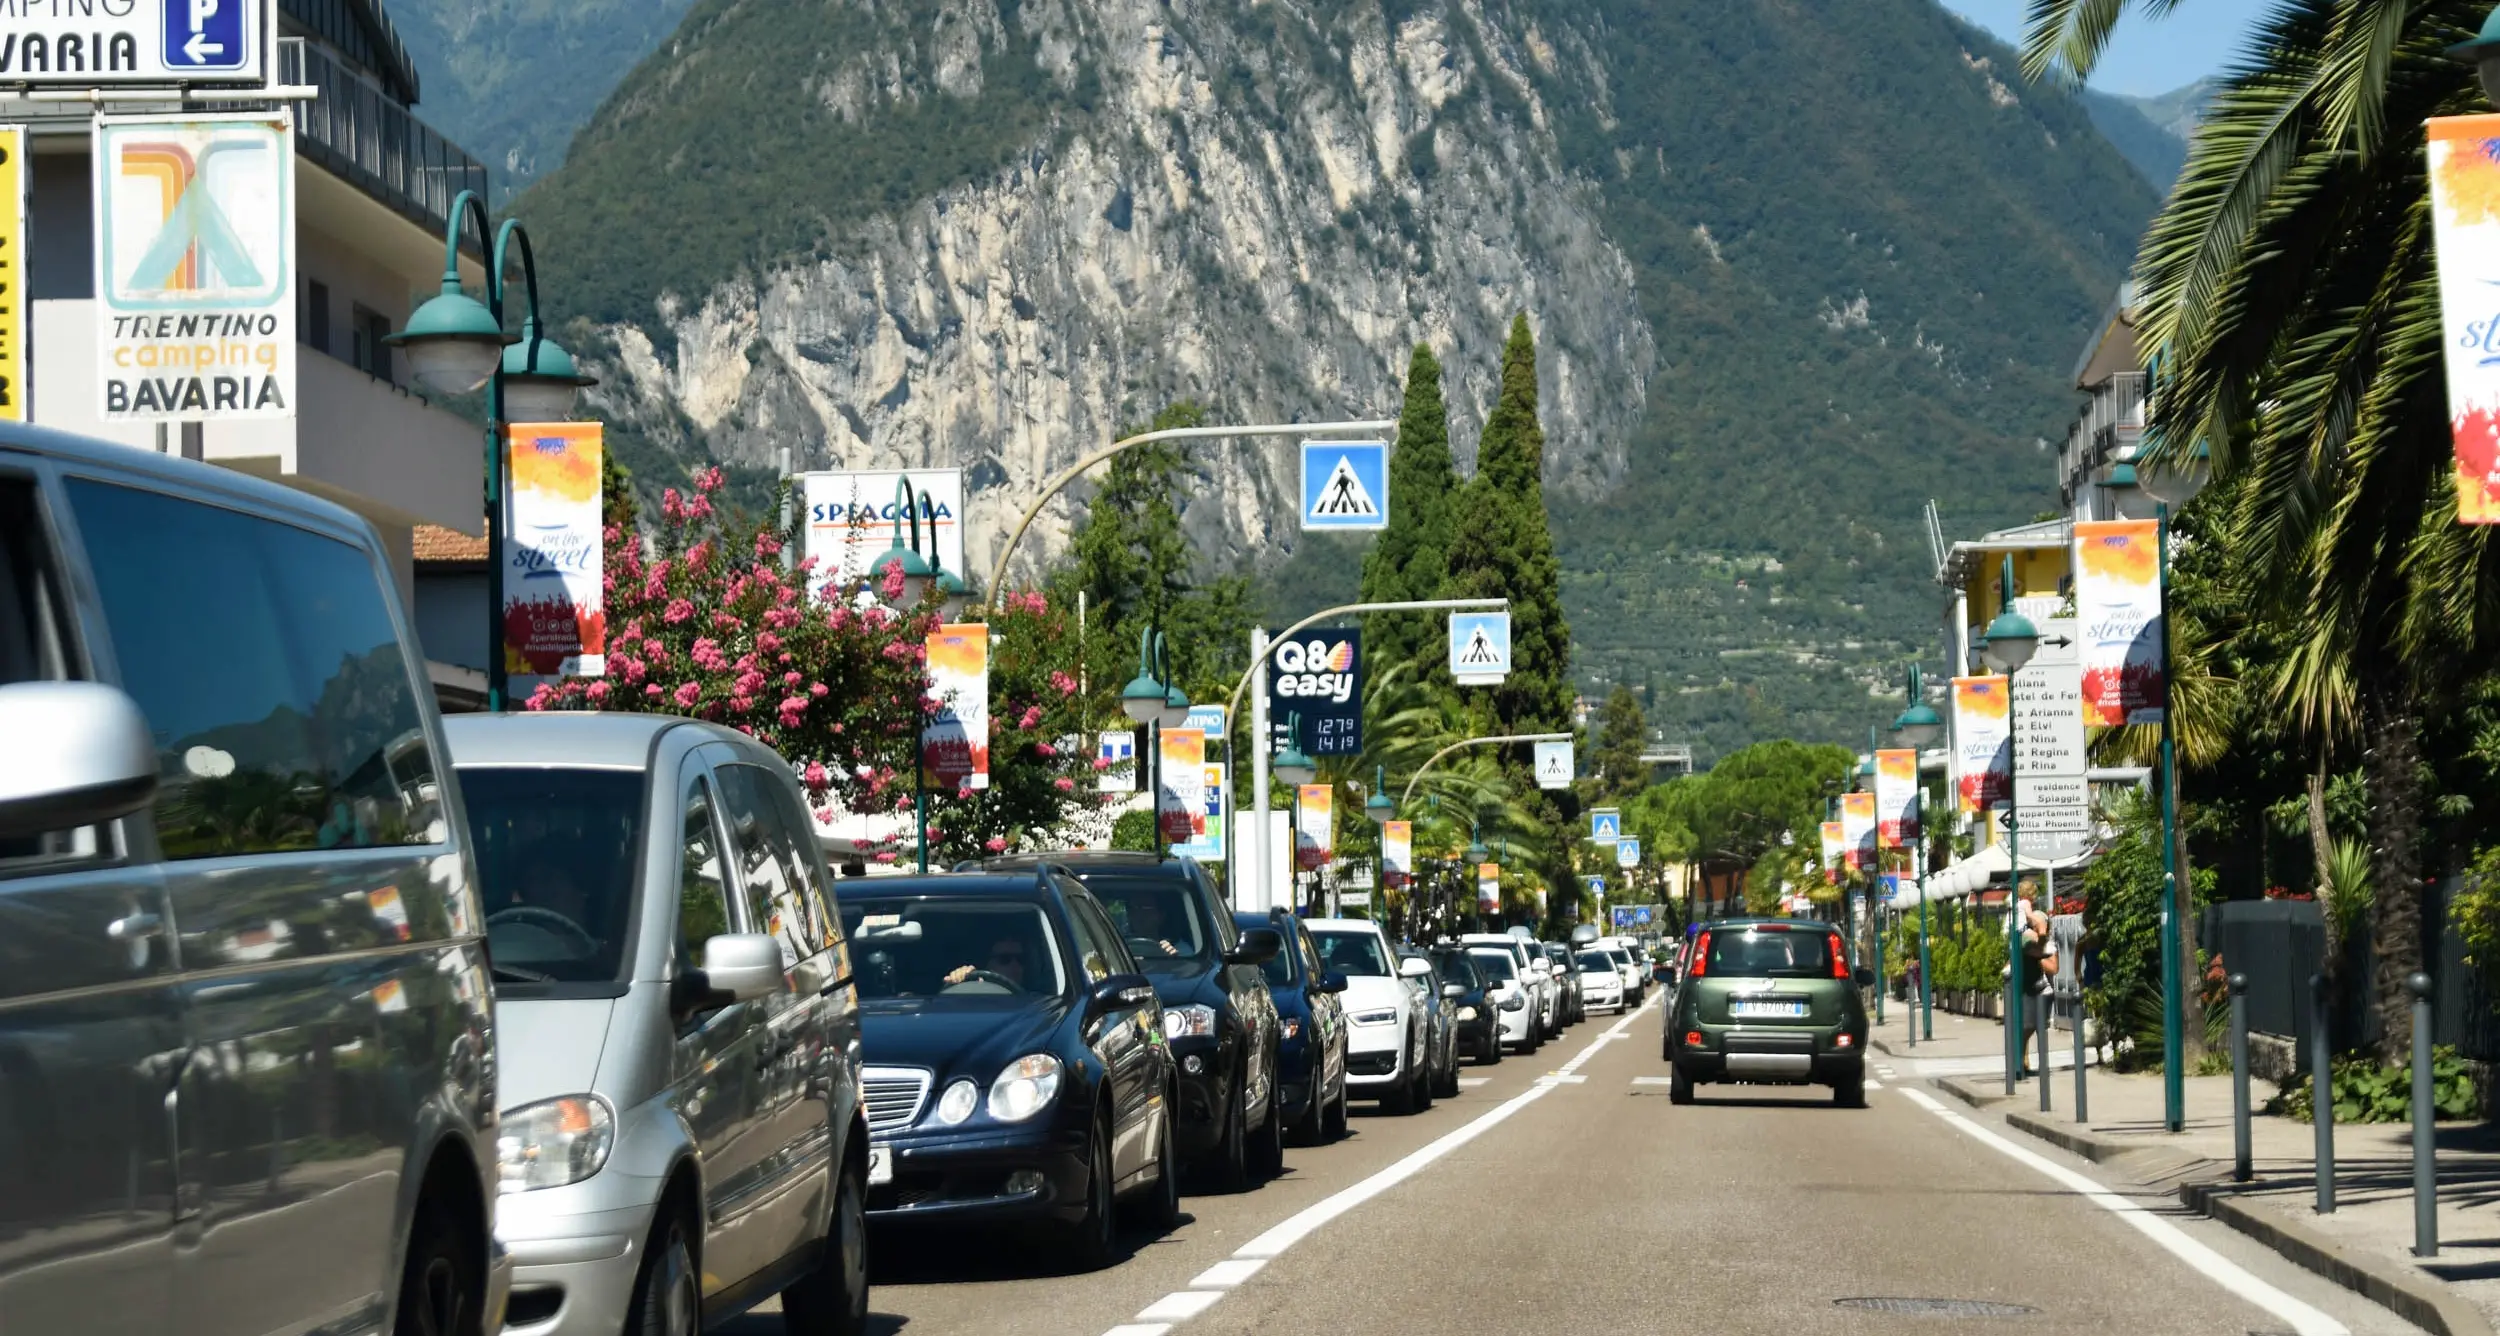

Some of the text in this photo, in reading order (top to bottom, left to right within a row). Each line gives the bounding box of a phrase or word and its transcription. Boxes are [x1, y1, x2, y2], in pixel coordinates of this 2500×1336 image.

[113, 313, 278, 338] TRENTINO
[113, 339, 278, 374] camping
[107, 374, 286, 412] BAVARIA
[513, 544, 593, 571] street
[2087, 619, 2153, 641] street
[1276, 640, 1327, 673] Q8
[1276, 673, 1354, 703] easy
[2030, 708, 2074, 717] Arianna
[2030, 721, 2052, 731] Elvi
[2031, 734, 2057, 743] Nina
[2031, 747, 2070, 758] Regina
[2031, 760, 2057, 770] Rina
[2033, 782, 2081, 791] residence
[2038, 794, 2081, 804] Spiaggia
[2020, 809, 2082, 819] appartamenti
[2045, 820, 2081, 828] Phoenix
